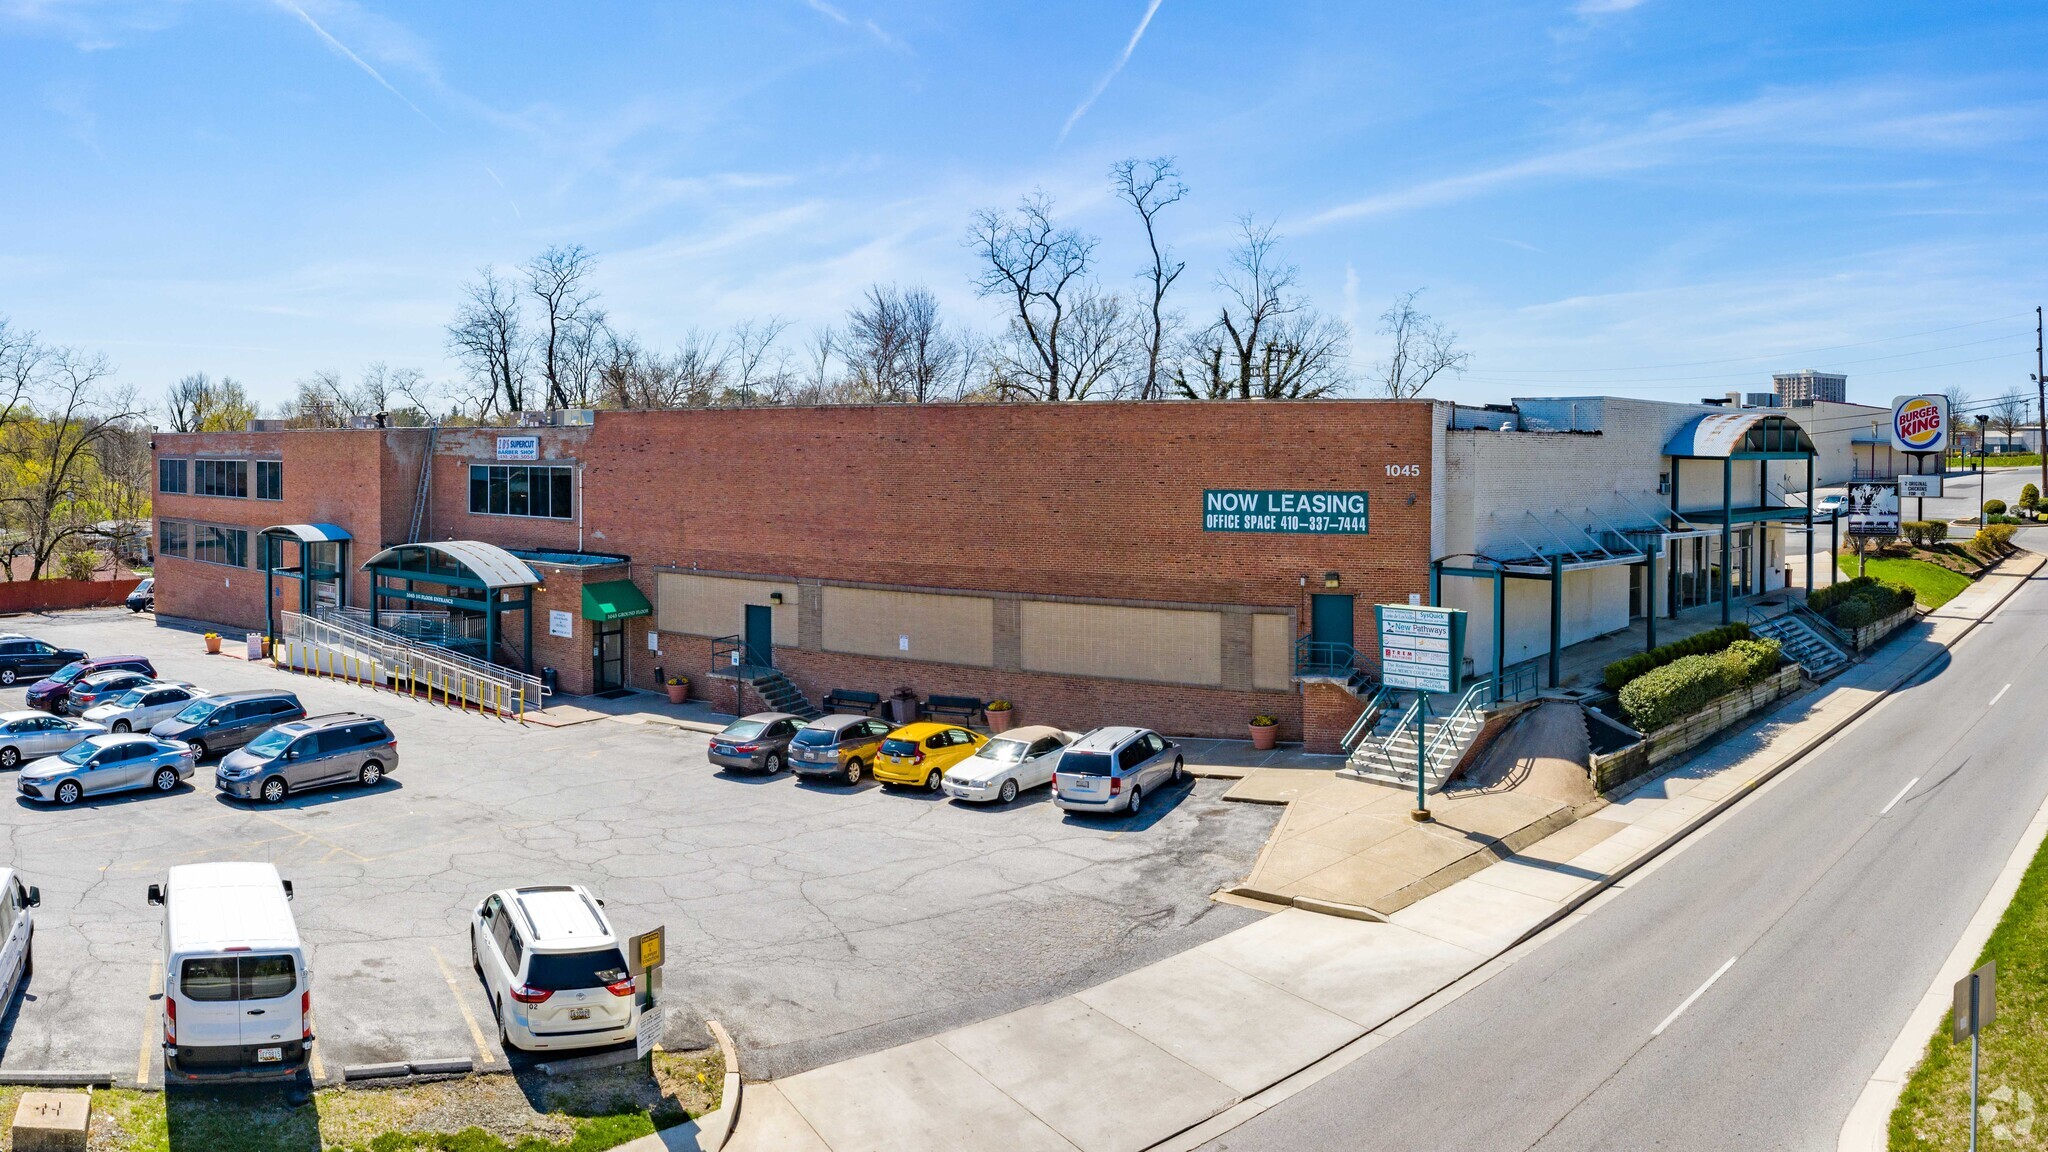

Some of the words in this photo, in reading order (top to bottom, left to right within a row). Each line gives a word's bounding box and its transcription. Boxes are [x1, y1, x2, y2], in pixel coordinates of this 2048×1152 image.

[1899, 406, 1938, 426] BURGER
[1901, 415, 1940, 439] KING
[510, 440, 535, 448] SUPERCUT
[1384, 464, 1420, 477] 1045
[1207, 493, 1259, 512] NOW
[1268, 494, 1365, 514] LEASING
[1206, 514, 1240, 529] OFFICE
[1244, 515, 1276, 530] SPACE
[618, 610, 636, 618] GROUND
[1420, 611, 1445, 619] SysQuick
[1395, 622, 1411, 631] New
[1412, 624, 1447, 636] Pathways
